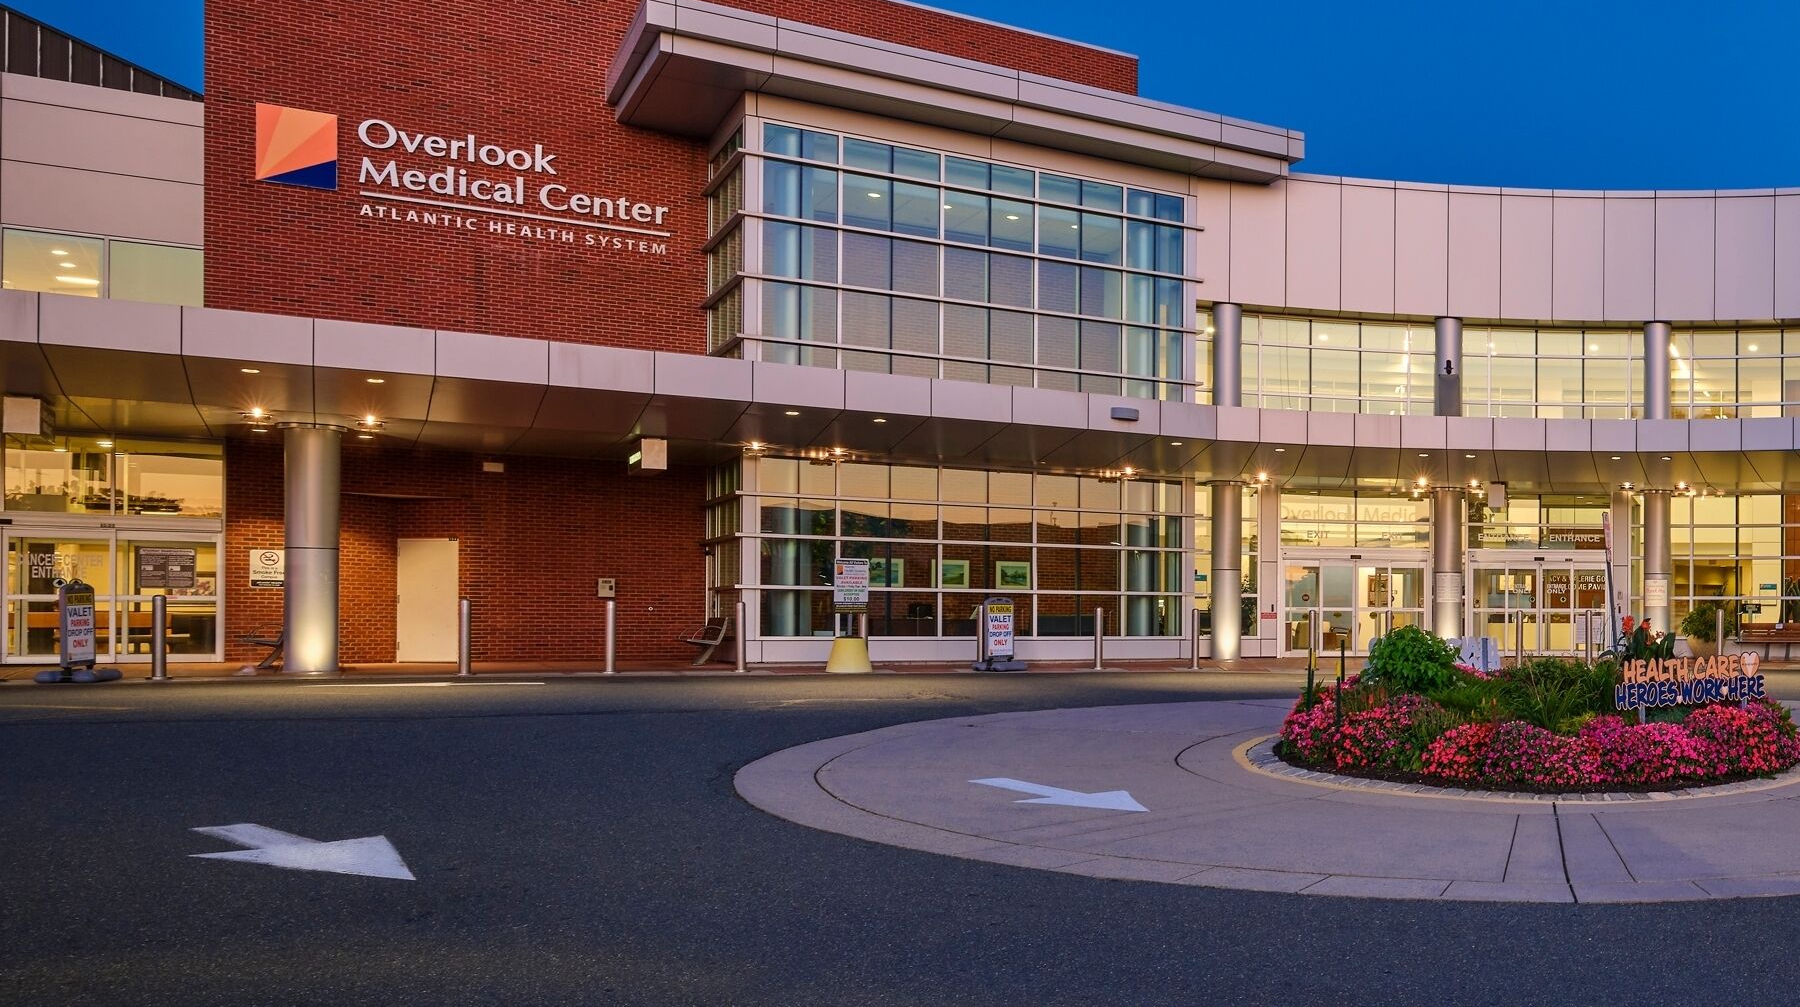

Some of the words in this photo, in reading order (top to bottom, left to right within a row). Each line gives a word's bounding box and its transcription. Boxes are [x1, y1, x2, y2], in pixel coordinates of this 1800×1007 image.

[357, 118, 557, 175] Overlook
[358, 156, 524, 205] Medical
[539, 184, 669, 225] Center
[360, 204, 478, 231] ATLANTIC
[489, 220, 574, 243] HEALTH
[585, 233, 667, 255] SYSTEM
[1306, 530, 1330, 539] EXIT
[1549, 534, 1600, 542] ENTRANCE
[67, 607, 92, 618] VALET
[996, 605, 1012, 613] PARKING
[70, 619, 90, 628] PARKING
[989, 615, 1012, 623] VALET
[67, 629, 82, 637] DROP
[83, 628, 94, 636] OFF
[72, 639, 88, 648] ONLY
[1624, 656, 1689, 684] HEALTH
[1693, 654, 1738, 680] CARE
[1615, 680, 1678, 711] HEROES
[1679, 678, 1728, 705] WORK
[1726, 674, 1767, 702] HERE
